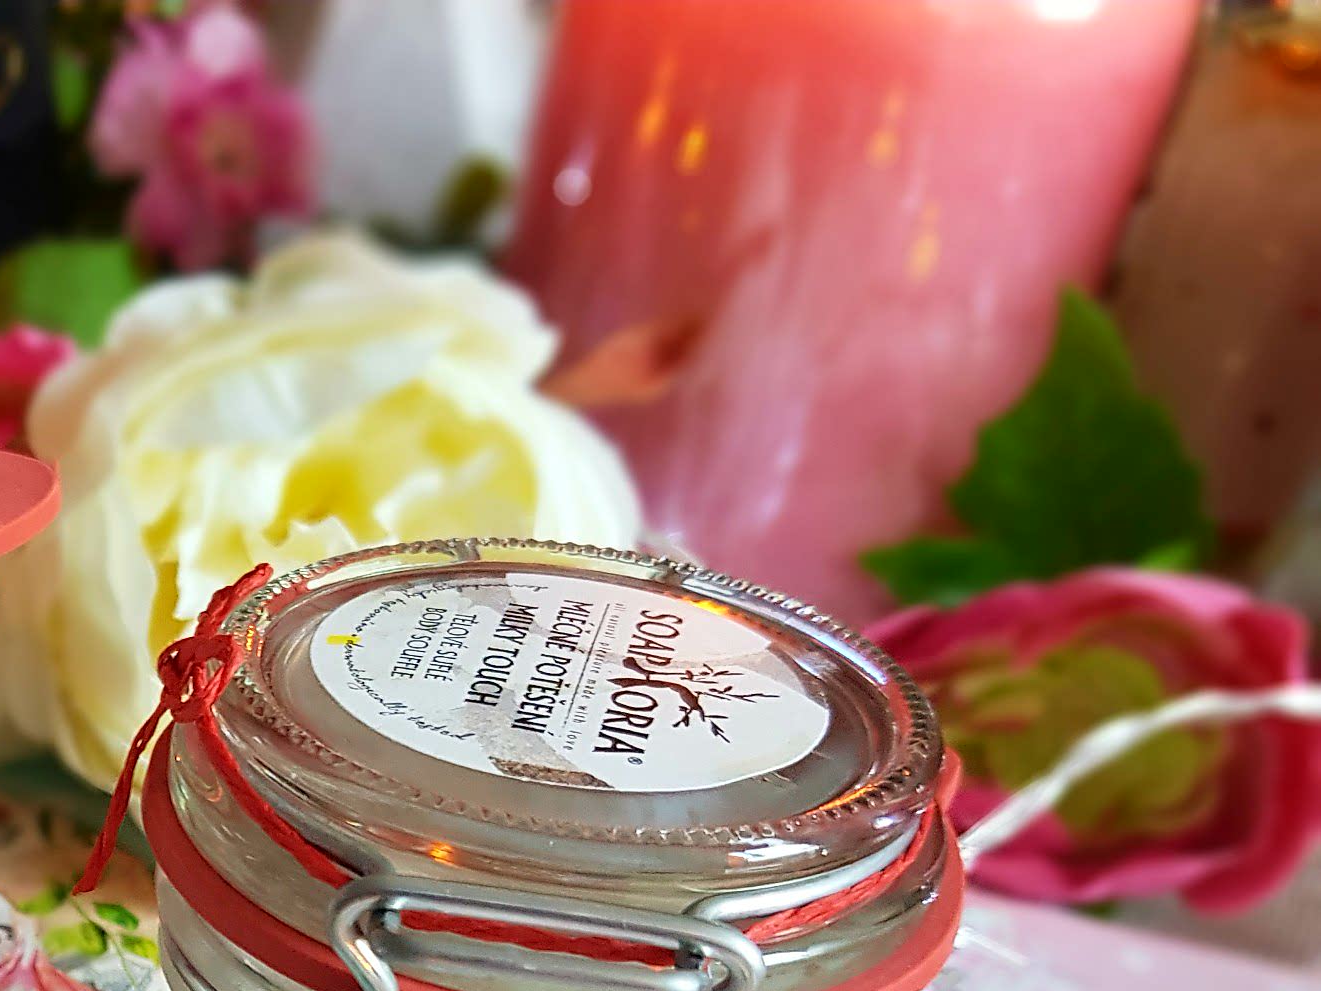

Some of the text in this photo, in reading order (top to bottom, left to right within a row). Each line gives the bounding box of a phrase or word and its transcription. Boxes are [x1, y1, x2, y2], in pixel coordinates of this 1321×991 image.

[390, 607, 447, 680] BODY SOUFFLE
[464, 602, 539, 707] MILKY TOUCH
[581, 678, 597, 700] made
[573, 705, 588, 724] with
[563, 730, 582, 751] love
